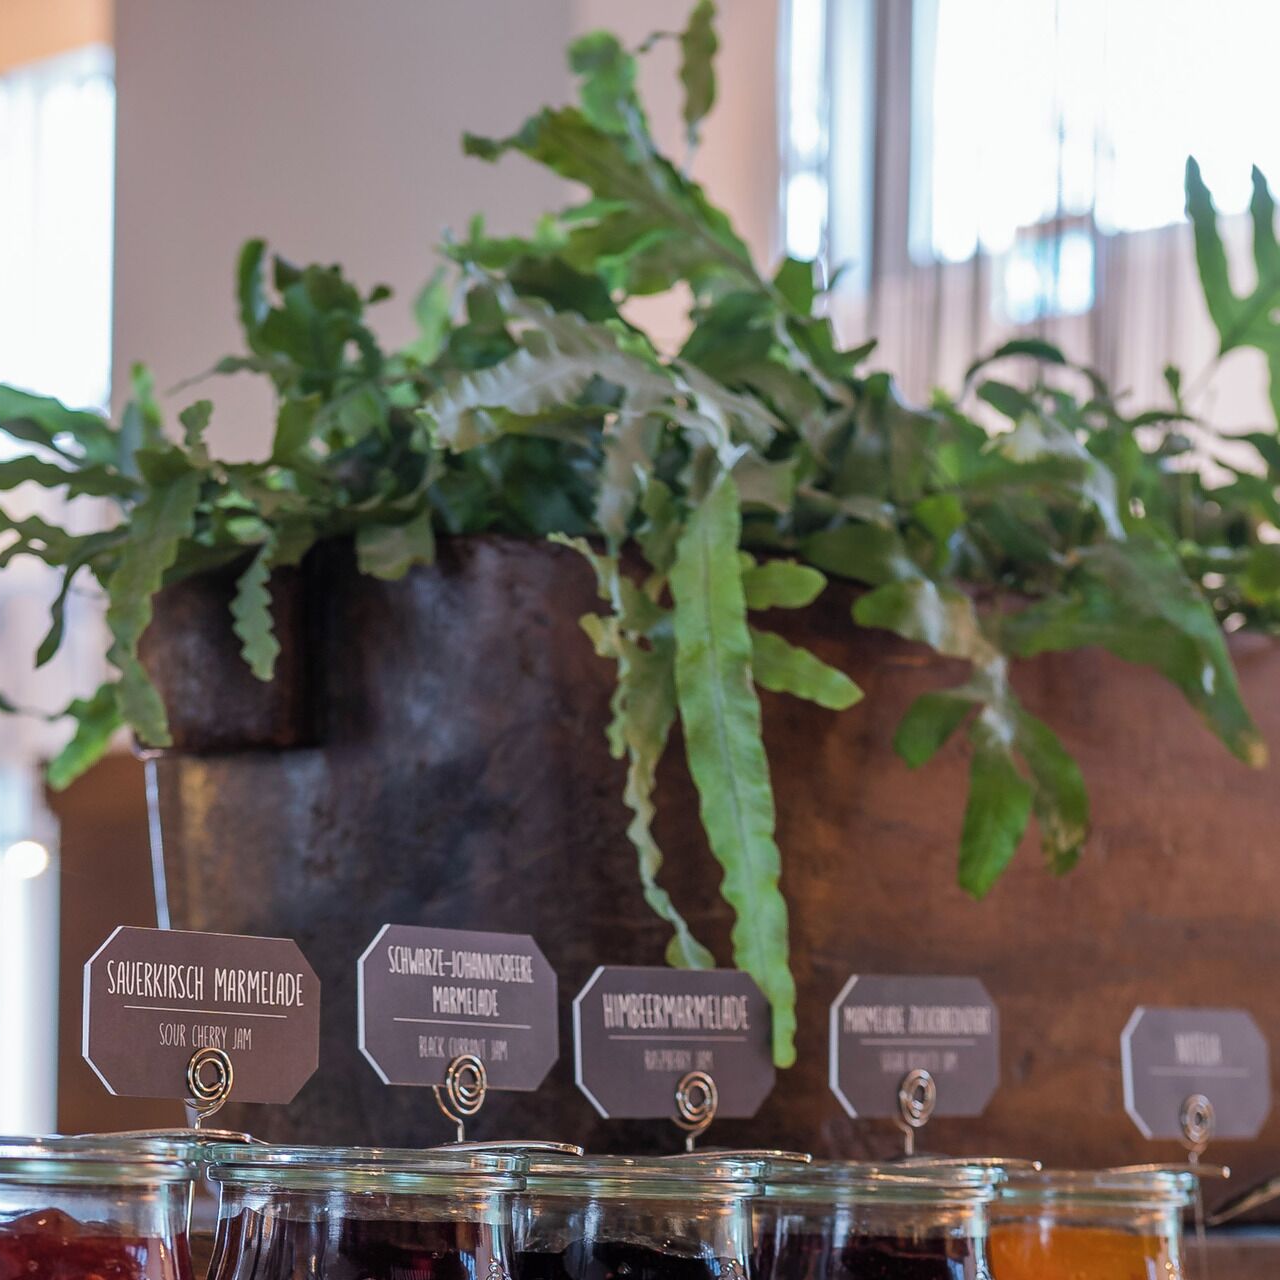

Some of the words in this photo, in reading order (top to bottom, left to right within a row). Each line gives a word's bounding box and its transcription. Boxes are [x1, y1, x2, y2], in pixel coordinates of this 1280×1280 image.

[106, 959, 204, 1001] SAUERKIRSCH
[213, 967, 305, 1007] MARMELADE
[432, 985, 500, 1017] MARMELADE
[159, 1022, 186, 1047] SOUR
[191, 1024, 228, 1050] CHERRY
[231, 1027, 253, 1051] JAM
